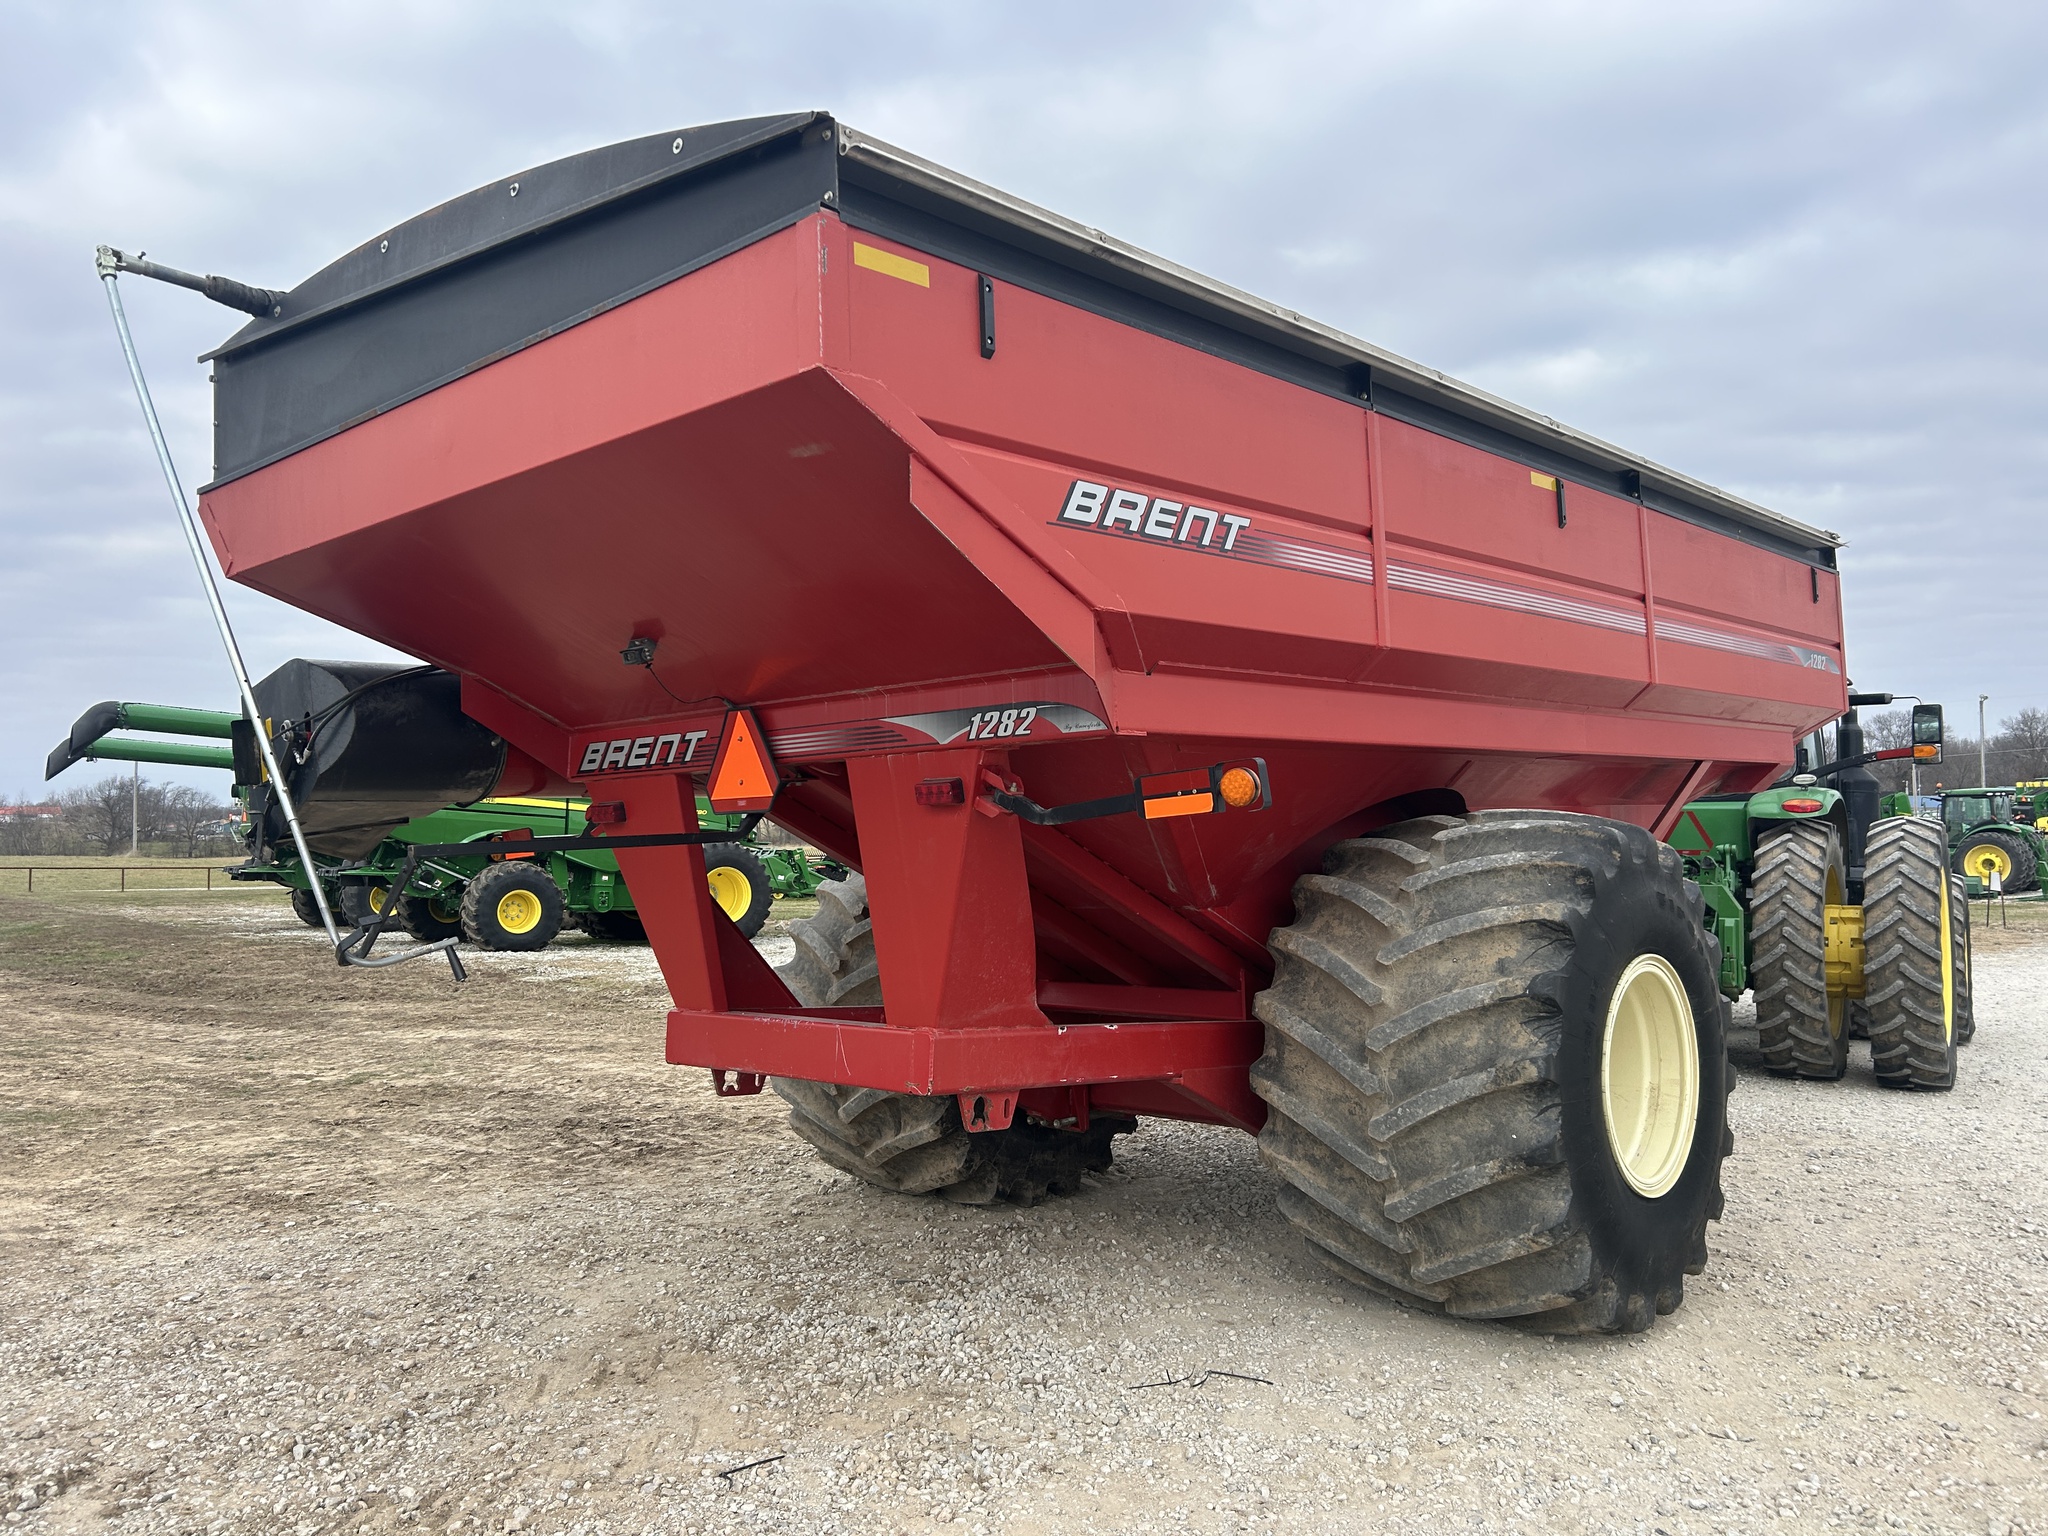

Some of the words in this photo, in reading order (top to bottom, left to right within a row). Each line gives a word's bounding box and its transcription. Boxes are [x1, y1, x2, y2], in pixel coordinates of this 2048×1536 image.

[1058, 479, 1251, 552] BRENT
[1810, 653, 1826, 671] 1282
[967, 706, 1037, 741] 1282
[578, 729, 708, 774] BRENT
